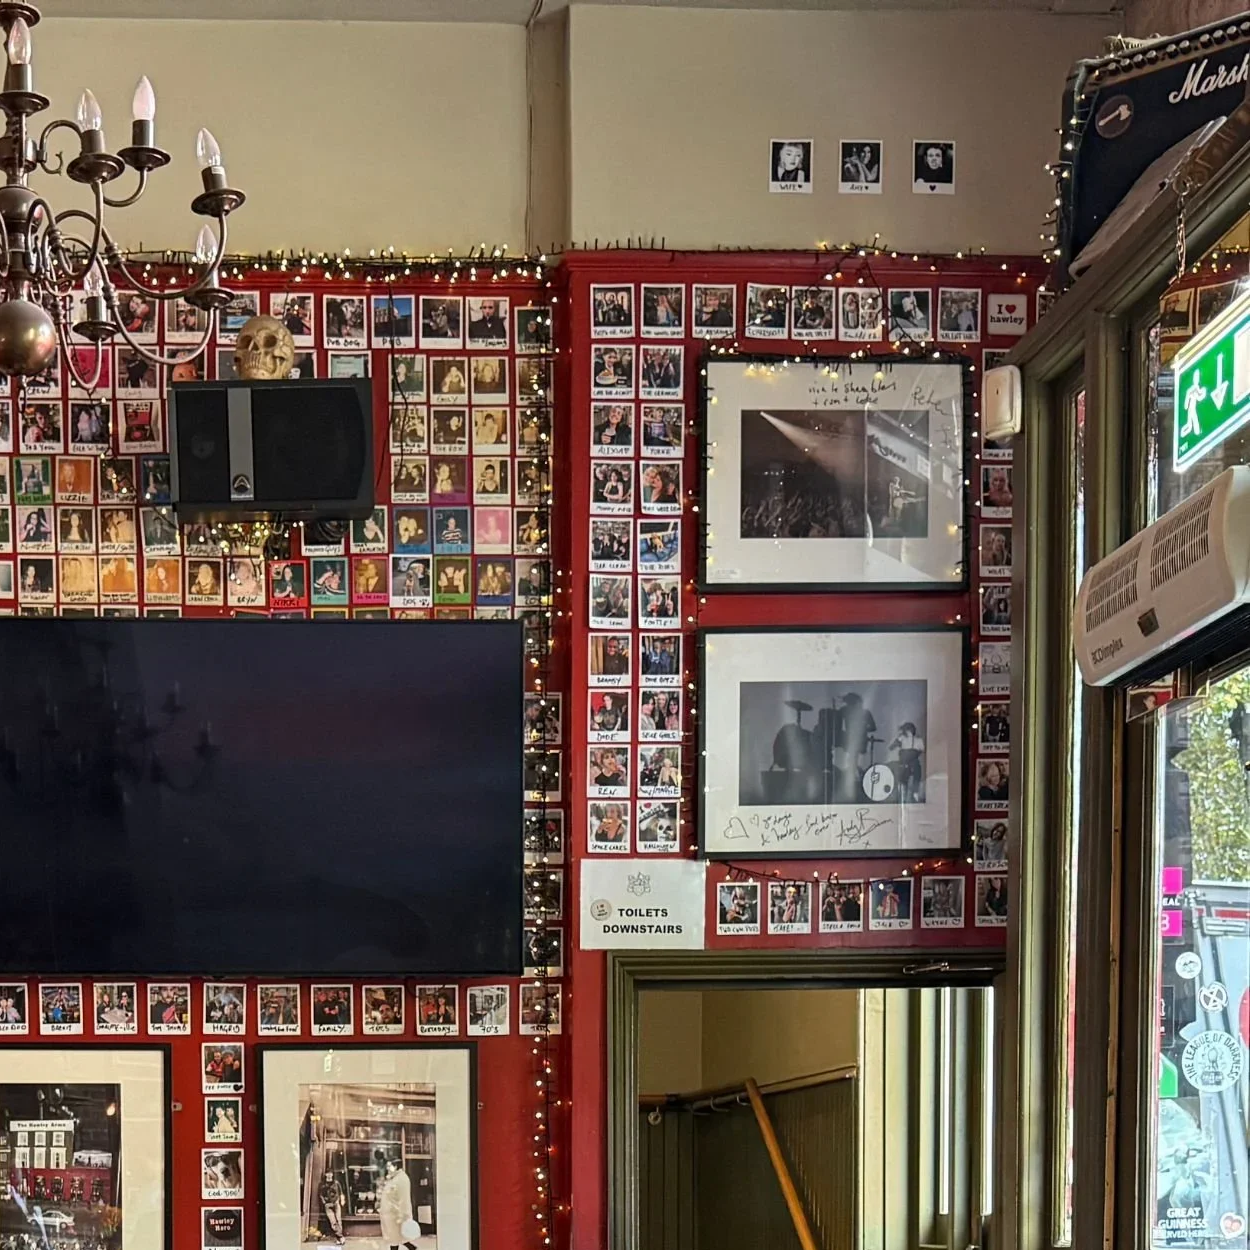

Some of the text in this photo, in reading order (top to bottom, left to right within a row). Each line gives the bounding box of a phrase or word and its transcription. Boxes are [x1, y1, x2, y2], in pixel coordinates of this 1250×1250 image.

[989, 315, 1025, 326] hawley
[618, 908, 668, 918] TOILETS
[602, 924, 683, 934] DOWNSTAIRS
[1166, 1207, 1201, 1218] GREAT
[1157, 1219, 1208, 1230] GUINNESS
